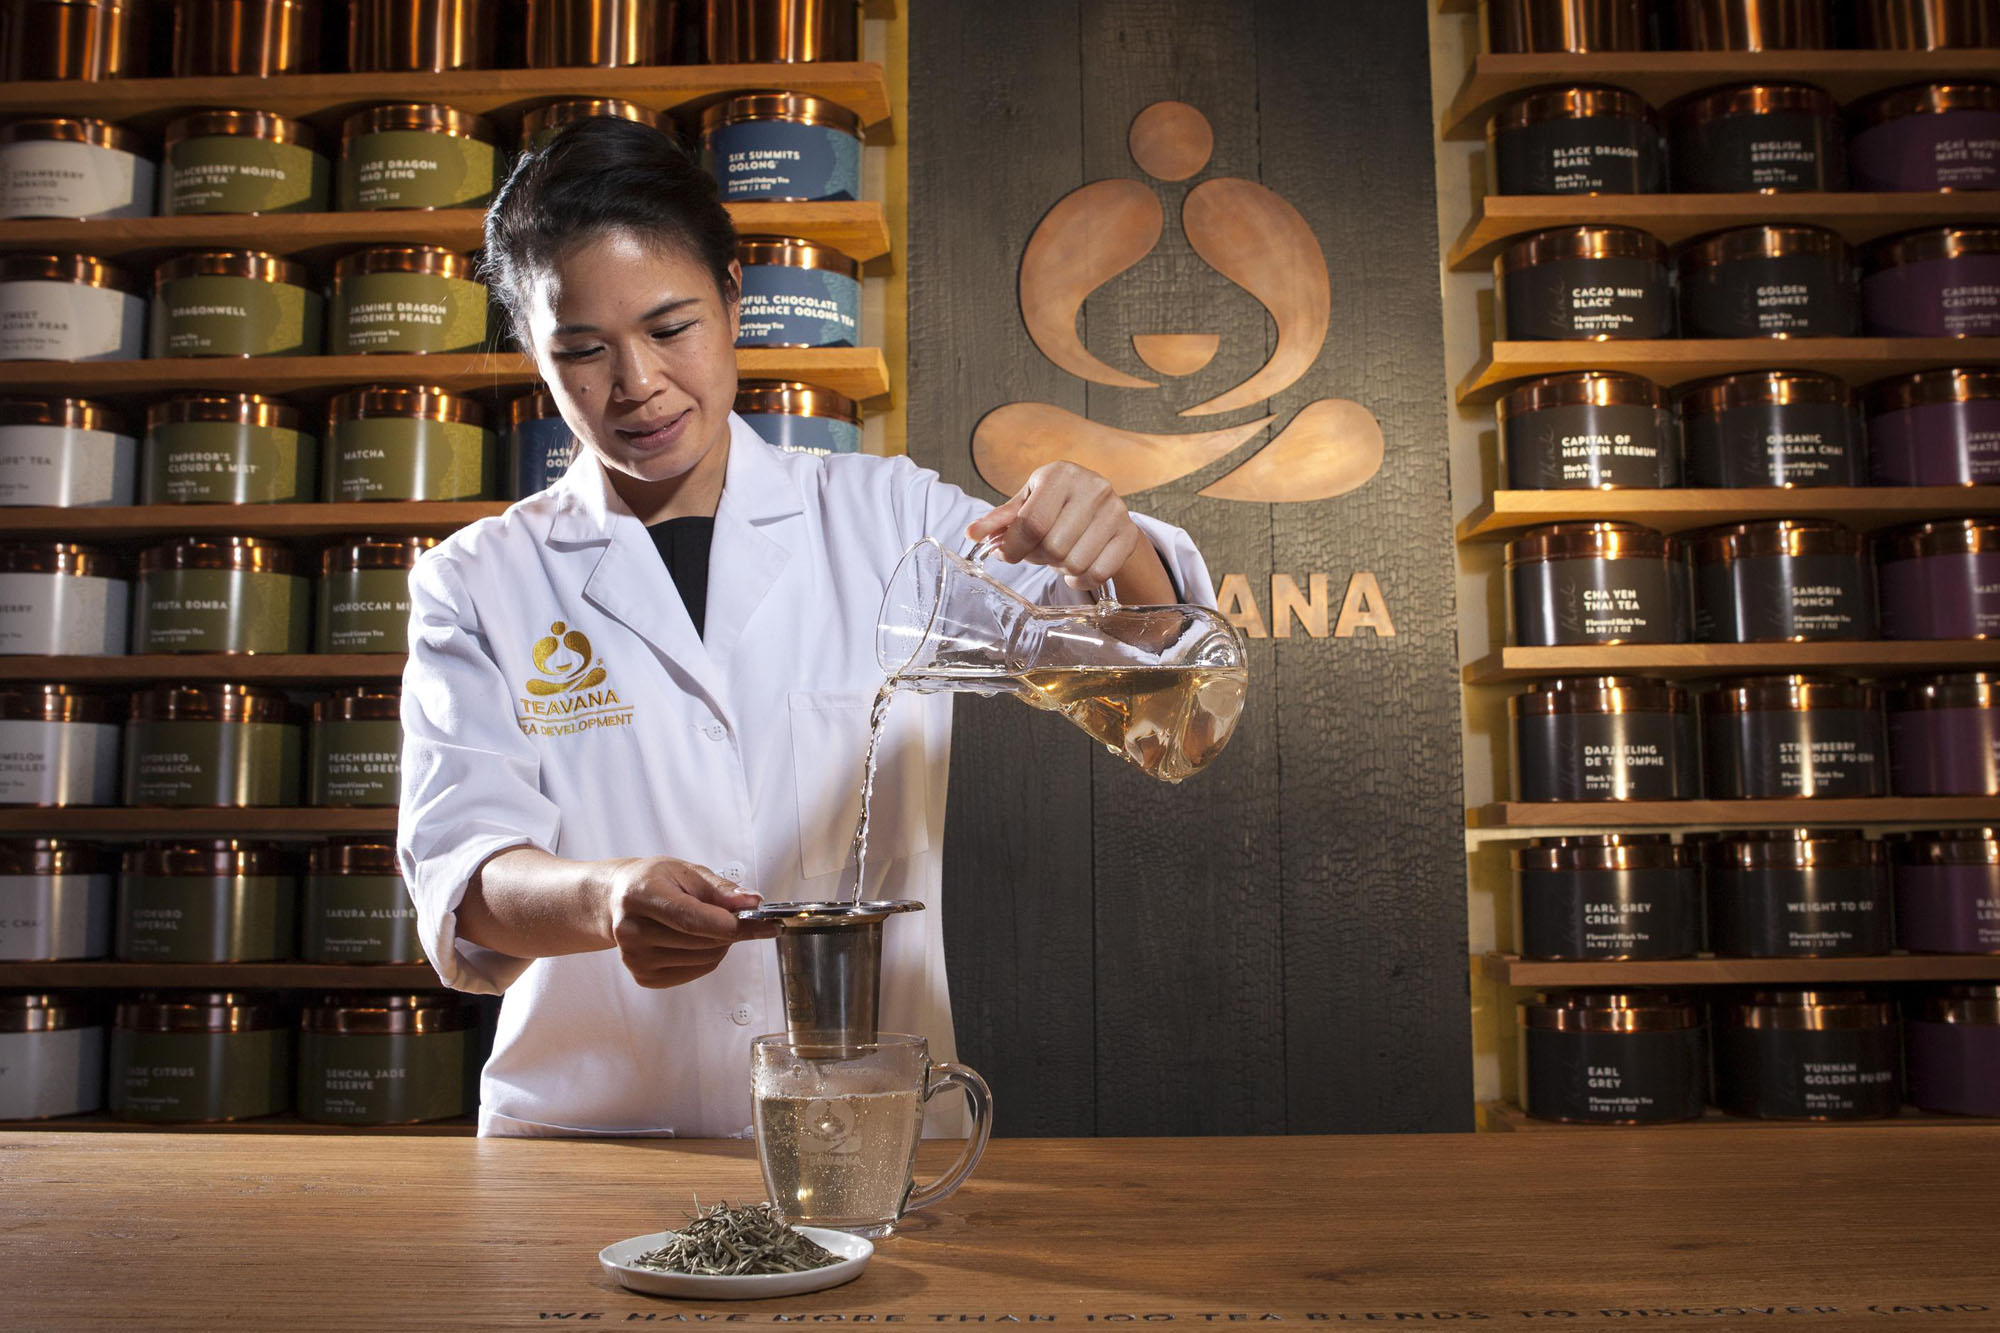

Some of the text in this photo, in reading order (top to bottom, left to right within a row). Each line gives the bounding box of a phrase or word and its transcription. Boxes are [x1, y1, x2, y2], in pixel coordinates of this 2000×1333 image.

[1553, 145, 1639, 158] BLACK DRAGON
[1751, 141, 1801, 152] ENGLISH
[728, 150, 801, 162] SIX SUMMITS
[1751, 152, 1815, 163] BREAKFAST
[361, 160, 438, 172] JADE DRAGON
[728, 160, 777, 173] OOLONG
[1553, 157, 1591, 168] PEARL
[240, 166, 286, 180] MOJITO
[384, 169, 416, 180] FENG
[206, 175, 228, 184] TEA
[1572, 287, 1644, 299] CACAO MINT
[1756, 284, 1808, 296] GOLDEN
[772, 295, 838, 311] CHOCOLATE
[1572, 297, 1612, 309] BLACK
[1757, 295, 1809, 307] MONKEY
[172, 305, 247, 317] DRAGONWELL
[350, 302, 447, 315] JASMINE DRAGON
[349, 312, 443, 325] PHOENIX PEARLS
[794, 308, 839, 323] OOLONG
[841, 314, 855, 327] TEA
[1561, 434, 1631, 447] CAPITAL OF
[1766, 433, 1822, 444] ORGANIC
[343, 449, 385, 461] MATCHA
[1562, 446, 1657, 458] HEAVEN KEEMUN
[1767, 445, 1815, 455] MASALA
[169, 452, 231, 462] EMPEROR'S
[168, 463, 211, 473] CLOUDS
[214, 463, 224, 473] &
[1584, 589, 1637, 601] CHA YEN
[1792, 586, 1843, 597] SANGRIA
[185, 600, 228, 610] BOMBA
[333, 602, 391, 612] MOROCCAN
[1217, 572, 1396, 639] ANA
[1584, 600, 1640, 611] THAI TEA
[1792, 597, 1835, 607] PUNCH
[520, 689, 620, 716] TEAVANA
[541, 713, 633, 736] DEVELOPMENT
[329, 752, 398, 762] PEACHBERRY
[1584, 756, 1602, 767] DE
[1584, 903, 1652, 913] EARL GREY
[1787, 901, 1874, 912] WEIGHT TO GO
[326, 908, 366, 918] SAKURA
[152, 1066, 195, 1078] CITRUS
[326, 1068, 406, 1079] SENCHA JADE
[1587, 1066, 1619, 1077] EARL
[1803, 1063, 1857, 1074] YUNNAN
[326, 1080, 374, 1090] RESERVE
[1587, 1078, 1622, 1088] GREY
[1804, 1074, 1857, 1085] GOLDEN
[539, 1312, 605, 1320] WE
[627, 1312, 750, 1322] HAVE
[772, 1313, 906, 1323] MORE
[928, 1313, 1056, 1322] THAN
[1083, 1312, 1176, 1322] 100
[1196, 1312, 1285, 1322] TEA
[1305, 1310, 1491, 1321] BLENDS
[1518, 1308, 1580, 1319] TO
[1600, 1304, 1842, 1318] DISCOVER
